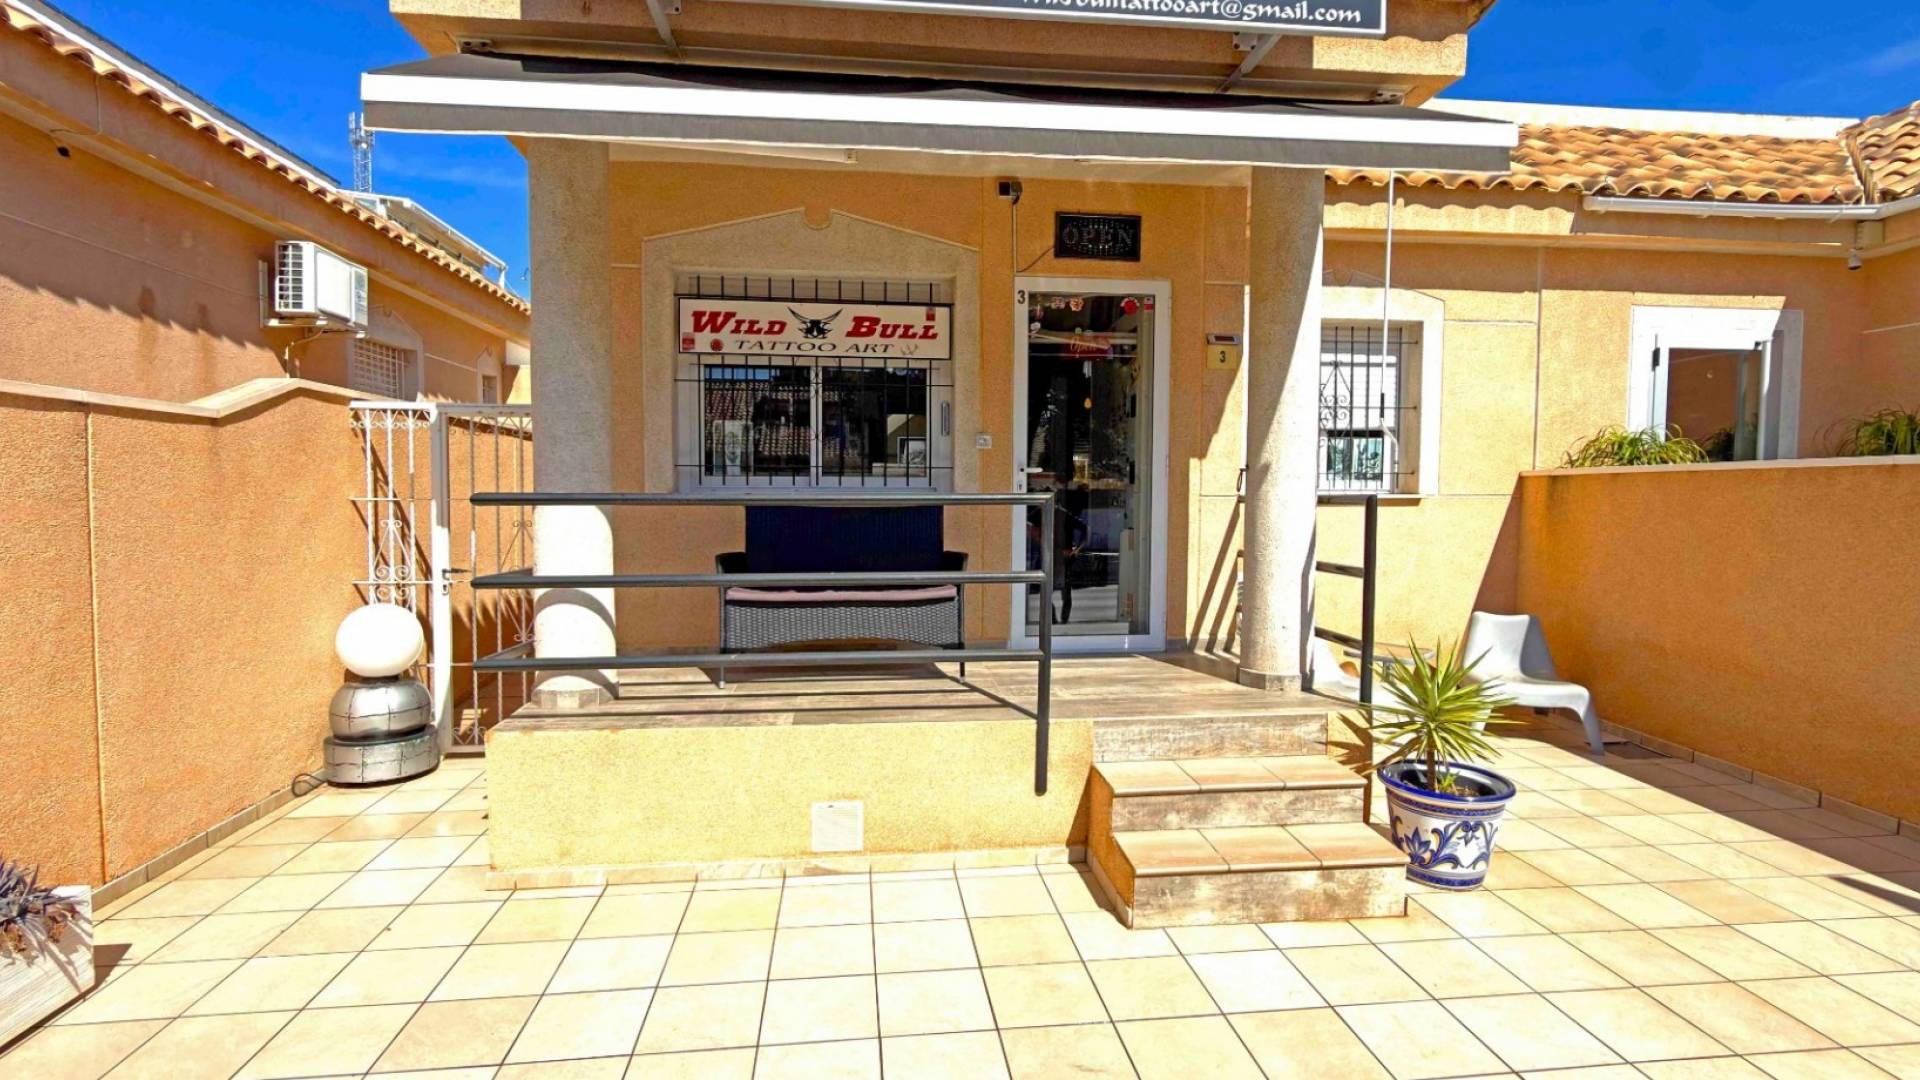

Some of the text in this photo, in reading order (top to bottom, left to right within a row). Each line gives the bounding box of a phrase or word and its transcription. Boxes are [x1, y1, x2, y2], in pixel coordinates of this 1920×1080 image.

[1022, 0, 1361, 23] utattooart@gmail.com
[1063, 228, 1134, 247] OPEN
[1017, 290, 1026, 304] 3
[691, 310, 938, 340] WILD BULL
[735, 340, 894, 353] TATTOO ART
[1219, 350, 1226, 363] 3
